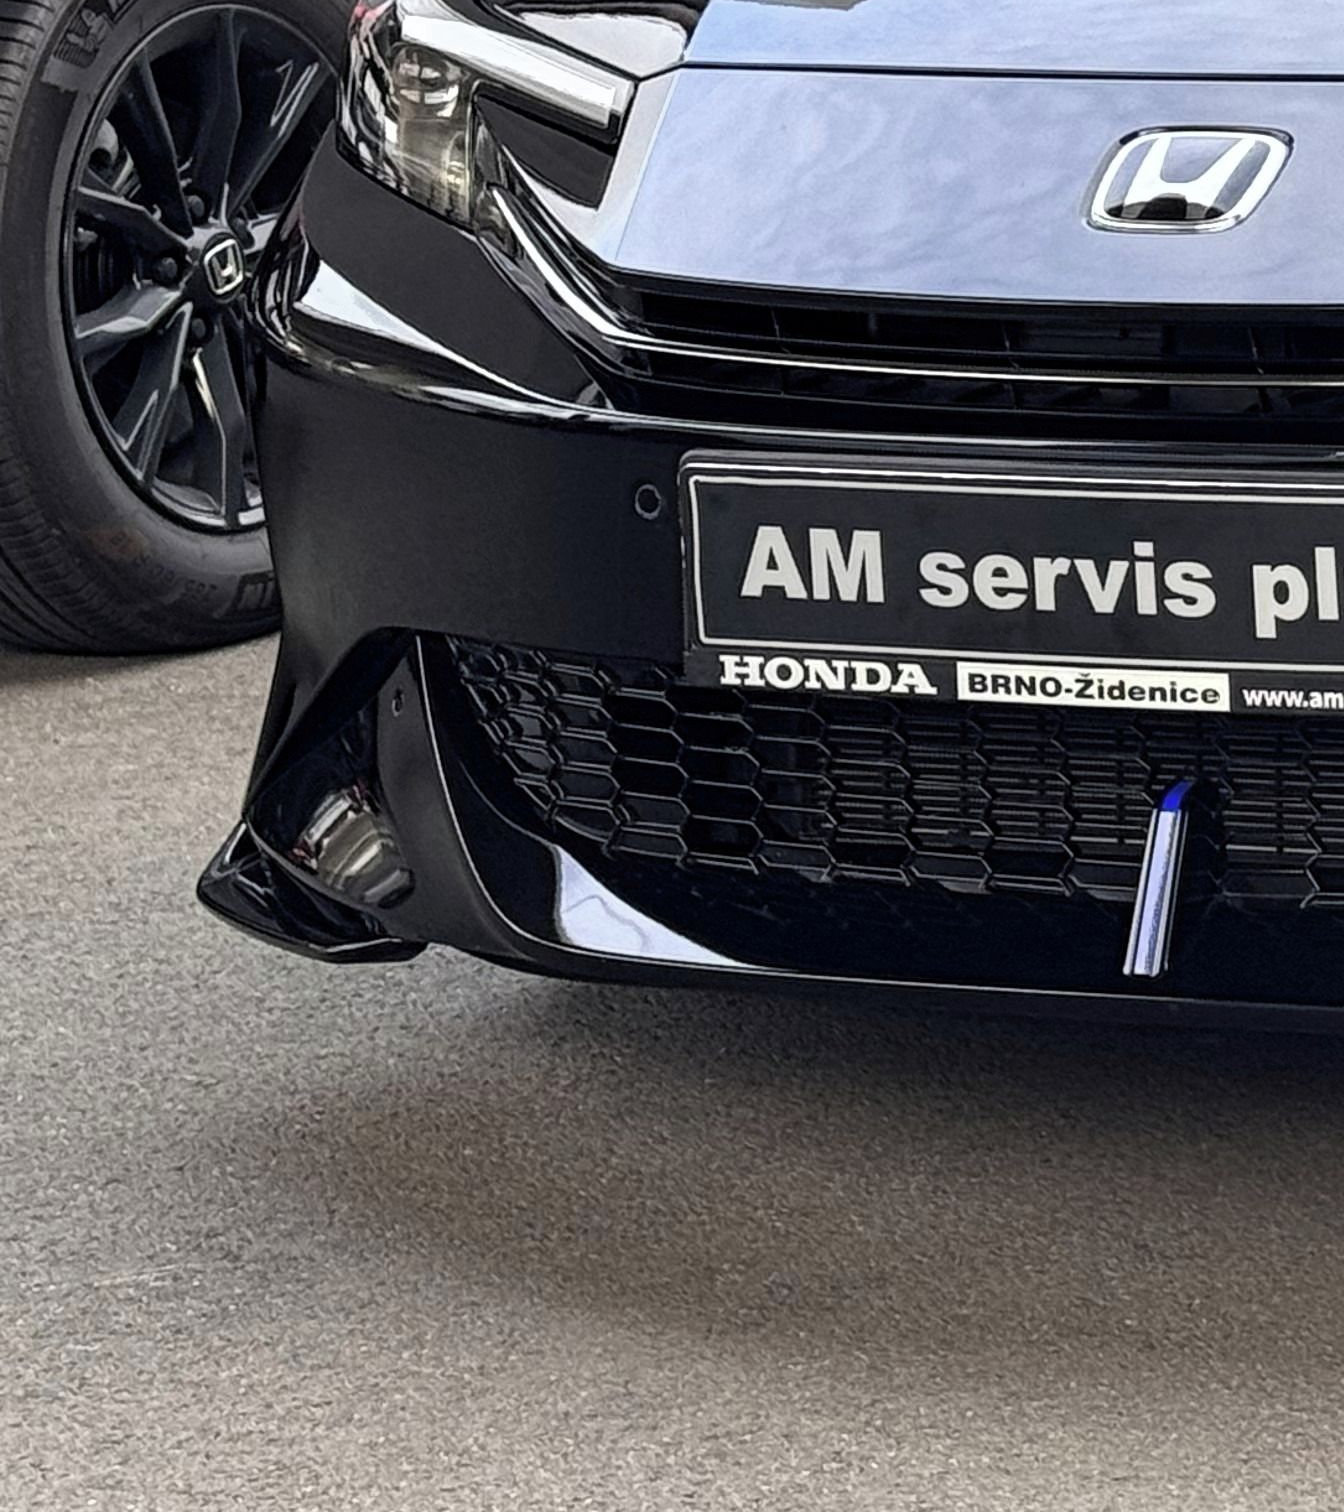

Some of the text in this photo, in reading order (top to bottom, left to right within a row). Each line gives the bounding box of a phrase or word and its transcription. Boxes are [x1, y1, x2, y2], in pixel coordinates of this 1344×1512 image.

[740, 525, 885, 603] AM
[919, 541, 1217, 618] servis
[718, 654, 938, 695] HONDA
[967, 672, 1221, 706] BRNO-Židenice
